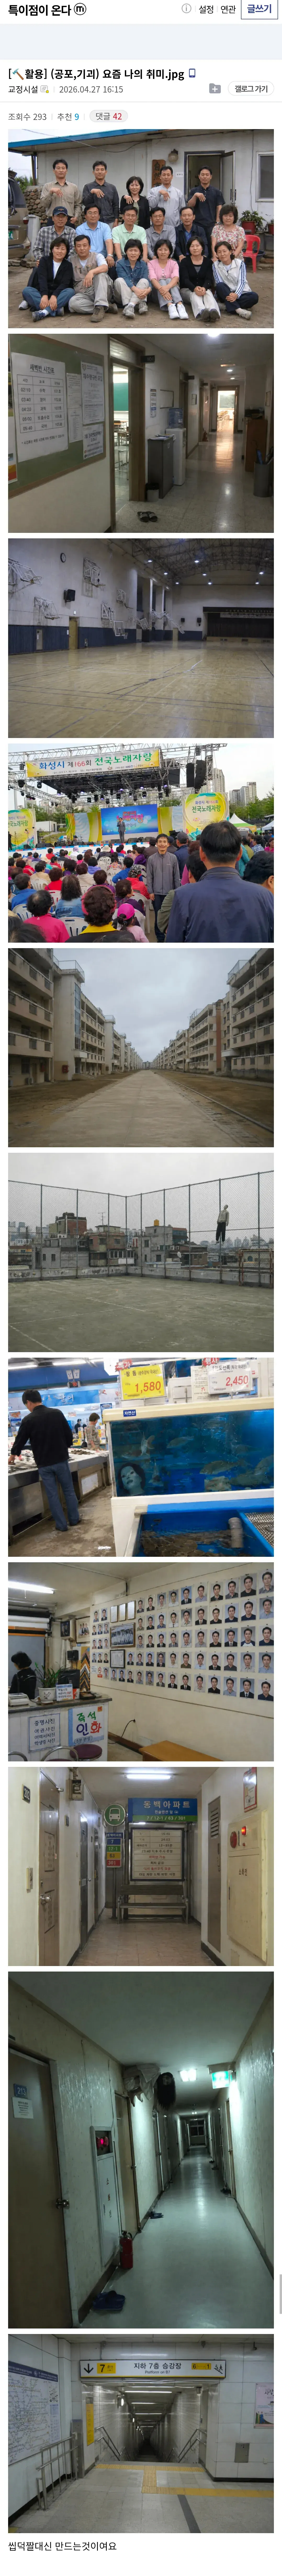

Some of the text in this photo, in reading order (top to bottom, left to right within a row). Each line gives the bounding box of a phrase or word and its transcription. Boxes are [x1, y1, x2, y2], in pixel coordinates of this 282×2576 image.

[39, 761, 64, 770] 화성시
[94, 753, 152, 766] 전국노래자랑
[192, 805, 221, 813] 전국노래자랑
[135, 1381, 161, 1393] 1,580
[226, 1375, 249, 1387] 2,450
[77, 1711, 96, 1722] 즉석
[76, 1721, 102, 1736] 인화
[18, 2087, 26, 2096] 213
